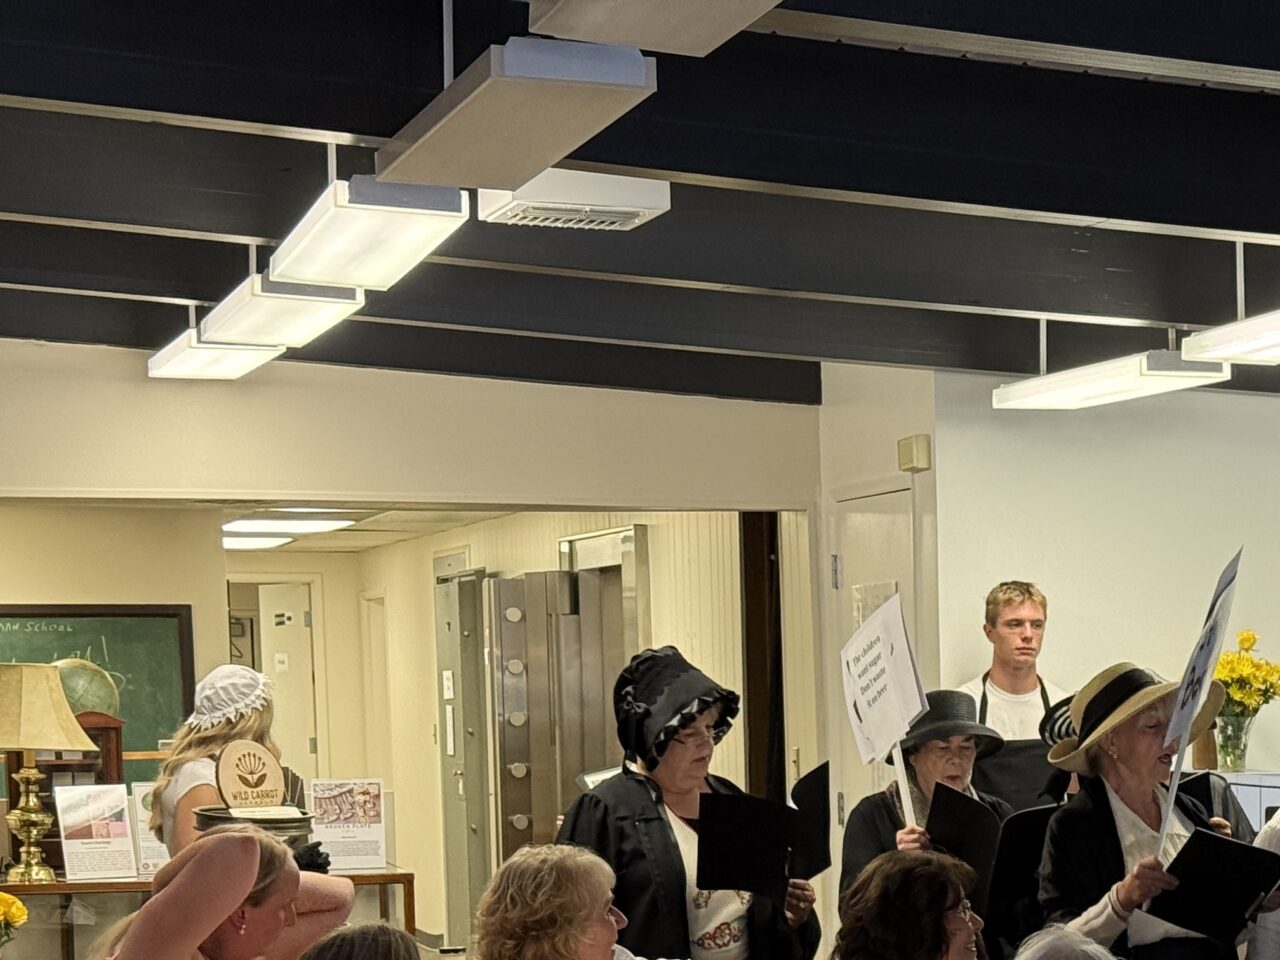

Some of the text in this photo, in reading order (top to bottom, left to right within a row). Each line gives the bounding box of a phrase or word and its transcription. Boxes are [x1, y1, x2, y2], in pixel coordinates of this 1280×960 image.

[862, 635, 881, 657] children
[231, 789, 278, 801] WILD CARROT
